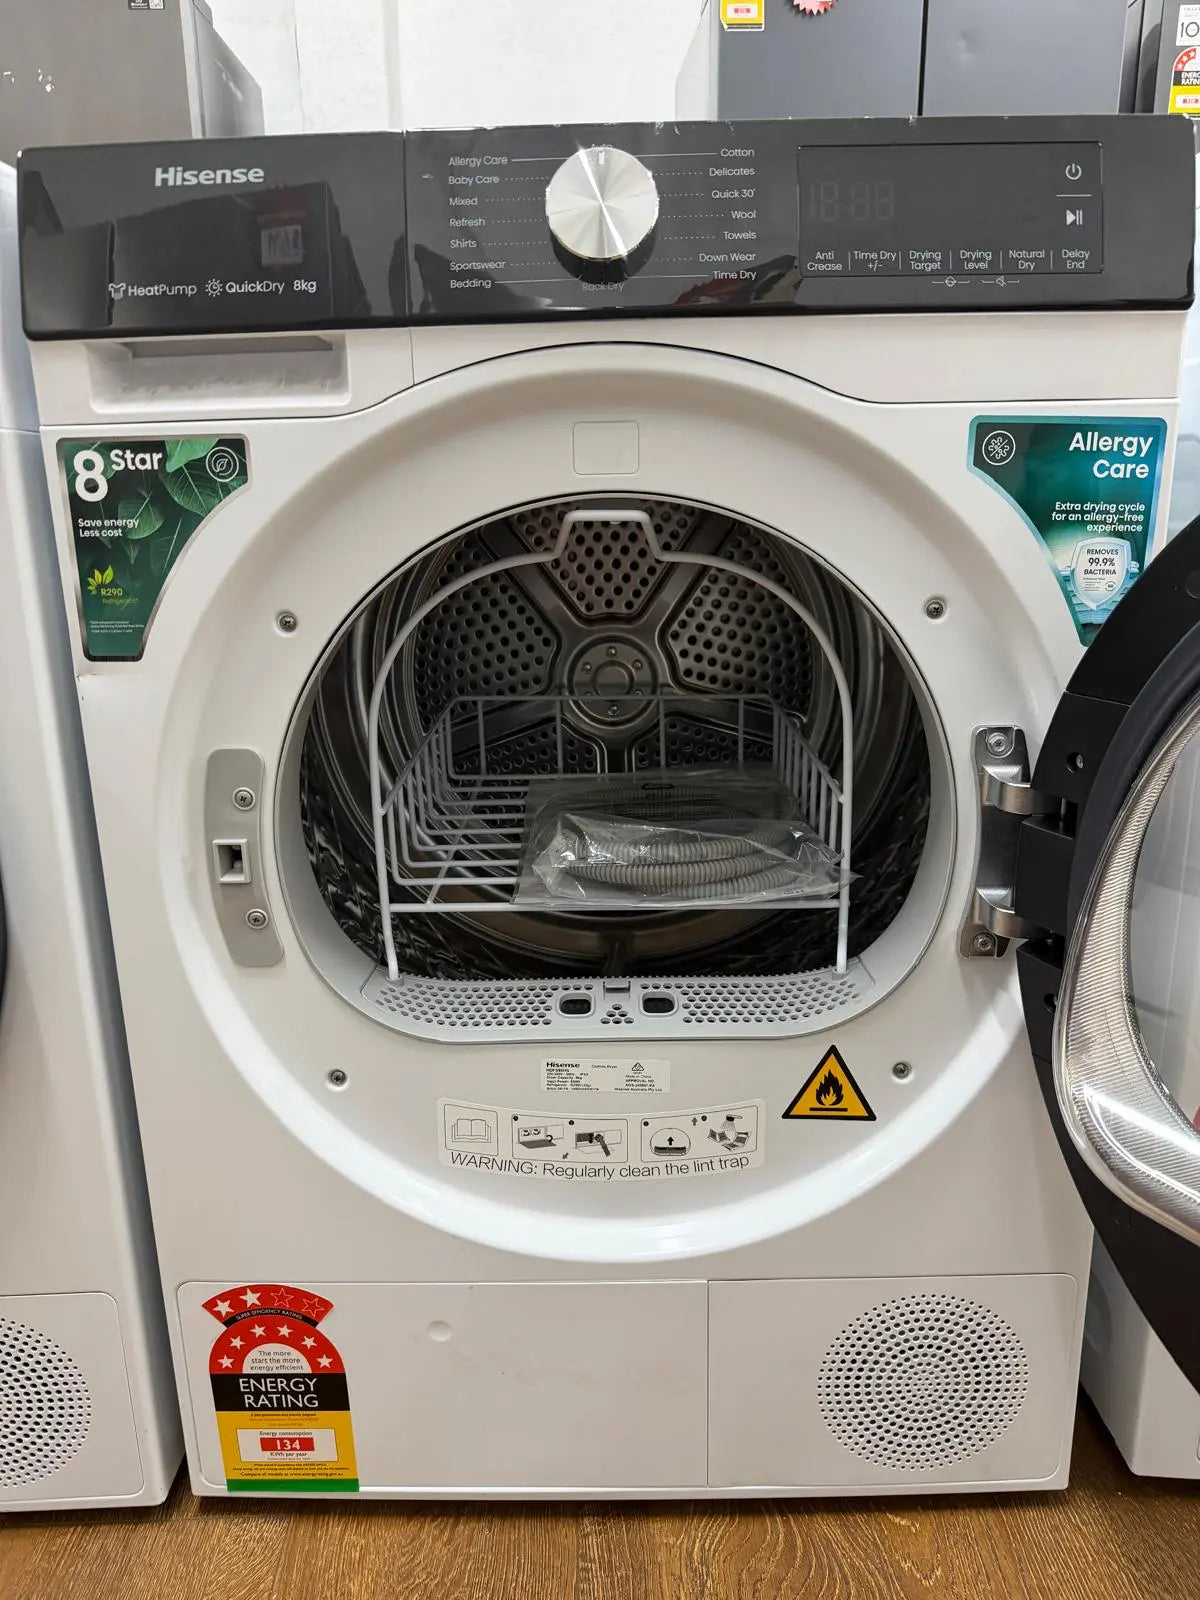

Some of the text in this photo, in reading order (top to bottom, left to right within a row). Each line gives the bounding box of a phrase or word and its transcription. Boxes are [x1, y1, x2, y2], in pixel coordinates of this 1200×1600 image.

[449, 156, 508, 167] Allergy Care
[155, 167, 264, 186] Hisense
[710, 168, 755, 176] Delicates
[449, 176, 472, 186] Baby
[712, 190, 739, 198] Quick
[450, 197, 477, 205] Mixed
[731, 210, 756, 218] Wool
[450, 218, 485, 226] Refresh
[723, 231, 756, 239] Towels
[450, 239, 477, 248] Shirts
[730, 253, 756, 261] Wear
[816, 251, 834, 259] Anti
[854, 251, 896, 261] Time Dry
[909, 251, 941, 261] Drying
[960, 250, 992, 261] Drying
[1009, 249, 1044, 258] Natural
[1062, 250, 1090, 260] Delay
[450, 260, 507, 272] Sportswear
[807, 262, 842, 270] Crease
[867, 261, 883, 271] +/-
[910, 260, 941, 271] Target
[965, 261, 988, 269] Level
[1019, 261, 1035, 271] Dry
[1067, 260, 1085, 269] End
[712, 270, 756, 281] Time Dry
[226, 280, 316, 294] QuickDry 8kg
[451, 279, 491, 288] Bedding
[582, 282, 624, 292] Rack Dry
[128, 284, 196, 296] HeatPump
[1069, 432, 1153, 457] Allergy
[1093, 460, 1149, 478] Care
[74, 449, 162, 502] 8 Star
[1056, 502, 1145, 513] Extra drying cycle
[1052, 512, 1066, 520] for
[1084, 512, 1144, 523] allergy-free
[78, 518, 139, 528] Save energy
[1087, 523, 1143, 533] experience
[80, 528, 123, 537] Less cost
[1088, 558, 1115, 566] 99.9%
[101, 588, 122, 596] R290
[450, 1152, 749, 1180] WARNING: Regularly clean the lint trap
[236, 1312, 250, 1320] SUPER
[282, 1311, 302, 1319] RATING
[239, 1378, 316, 1391] ENERGY
[245, 1394, 318, 1407] RATING
[277, 1440, 300, 1450] 134
